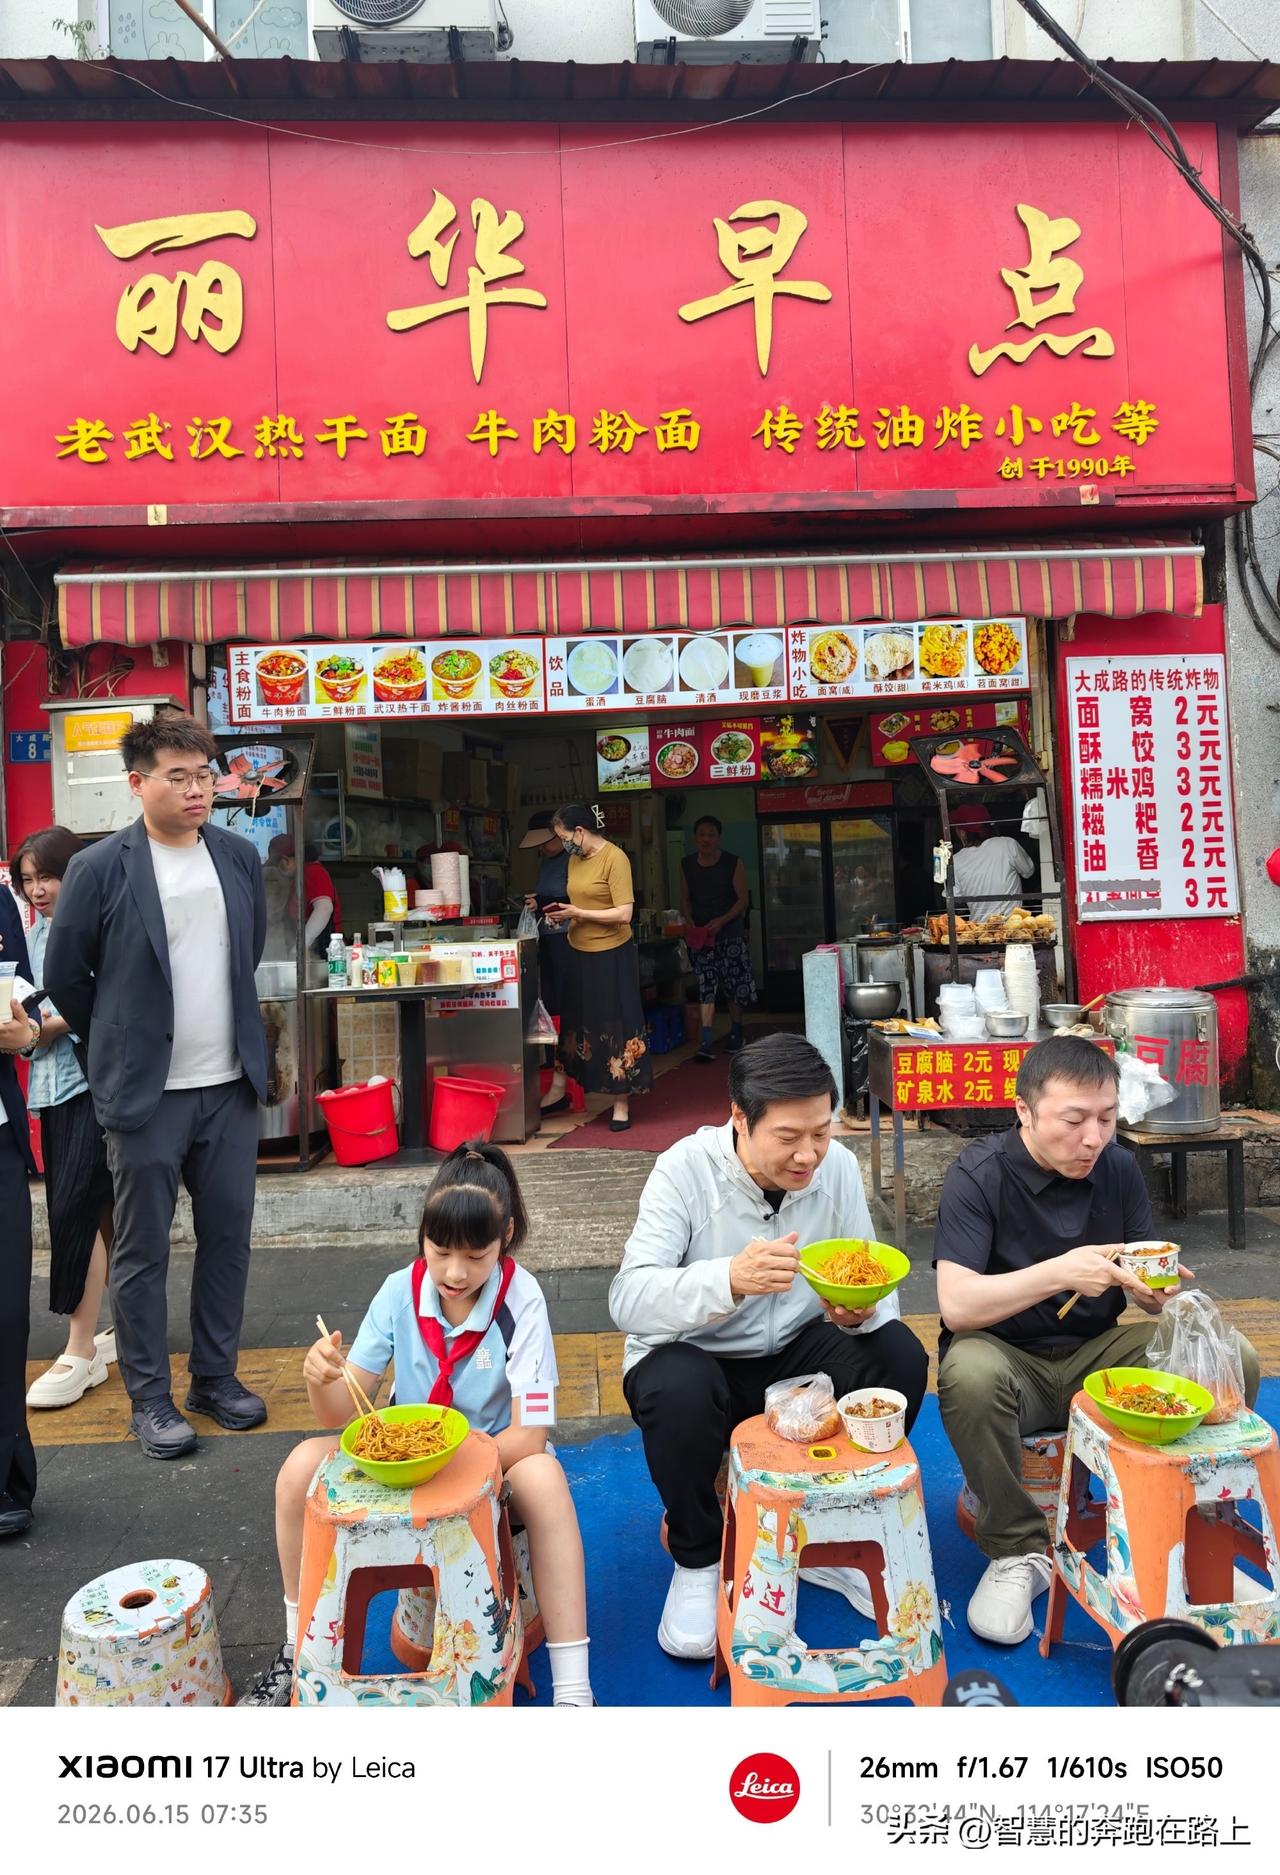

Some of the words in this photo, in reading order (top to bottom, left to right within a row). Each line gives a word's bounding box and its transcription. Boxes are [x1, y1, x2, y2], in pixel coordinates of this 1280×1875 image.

[94, 188, 1116, 385] 丽华早点
[55, 412, 429, 464] 老武汉热干面
[466, 407, 702, 457] 牛肉粉面
[753, 399, 1160, 456] 传统油炸小吃等
[997, 456, 1136, 481] 创于1990年
[549, 655, 564, 697] 饮品
[791, 630, 808, 699] 炸物小吃
[235, 651, 252, 719] 主食粉面
[1075, 668, 1220, 693] 大成路的传统炸物
[437, 701, 483, 713] 炸酱粉面
[494, 699, 539, 712] 肉丝粉面
[585, 696, 606, 707] 蛋酒
[635, 694, 668, 705] 豆腐脑
[695, 692, 717, 703] 清酒
[739, 689, 782, 702] 现磨豆浆
[261, 706, 308, 718] 牛肉粉面
[321, 704, 368, 716] 三鲜粉面
[373, 702, 431, 715] 武汉热干面
[1174, 694, 1219, 727] 2元
[1176, 730, 1222, 761] 3元
[1080, 766, 1155, 801] 糯米鸡
[1176, 765, 1222, 797] 3元
[1180, 801, 1225, 833] 2元
[1084, 837, 1159, 872] 油香
[1181, 836, 1227, 869] 2元
[1185, 876, 1229, 909] 3元
[897, 1051, 954, 1075] 豆腐脑
[963, 1050, 992, 1073] 2元
[897, 1079, 954, 1104] 矿泉水
[964, 1079, 993, 1102] 2元
